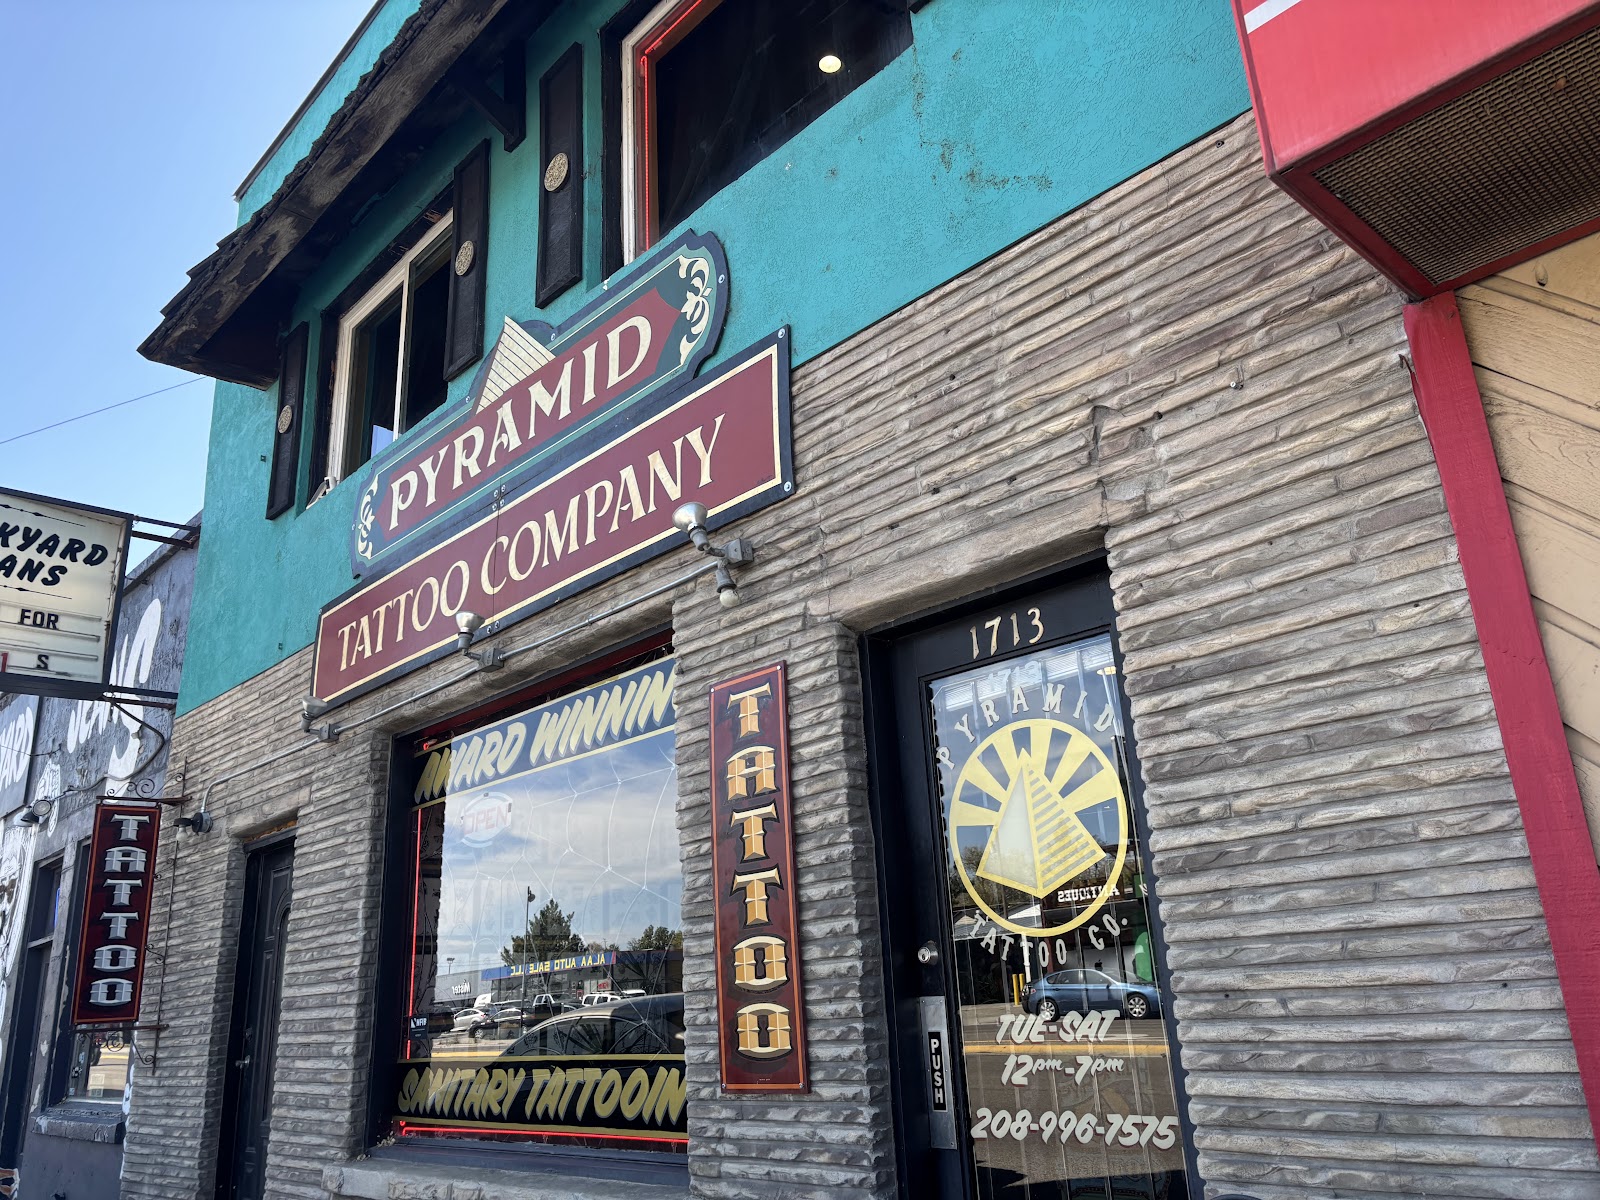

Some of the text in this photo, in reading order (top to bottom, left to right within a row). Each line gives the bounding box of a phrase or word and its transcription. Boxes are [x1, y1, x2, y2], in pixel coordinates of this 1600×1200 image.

[389, 314, 653, 531] PYRAMID
[0, 521, 108, 566] KYARD
[337, 413, 726, 673] TATTOO COMPANY
[19, 608, 59, 630] FOR
[970, 607, 1044, 659] 1713
[414, 668, 677, 804] AWARD WINNIN
[936, 682, 1115, 770] PYRAMID
[727, 682, 792, 1057] TATTOO
[88, 813, 150, 1007] TATTOO
[969, 911, 1128, 968] TATTOO CO.
[995, 1010, 1120, 1044] TUE-SAT
[398, 1066, 525, 1121] SANITARY
[930, 1038, 944, 1104] PUSH
[971, 1107, 1179, 1150] 208-996-7575
